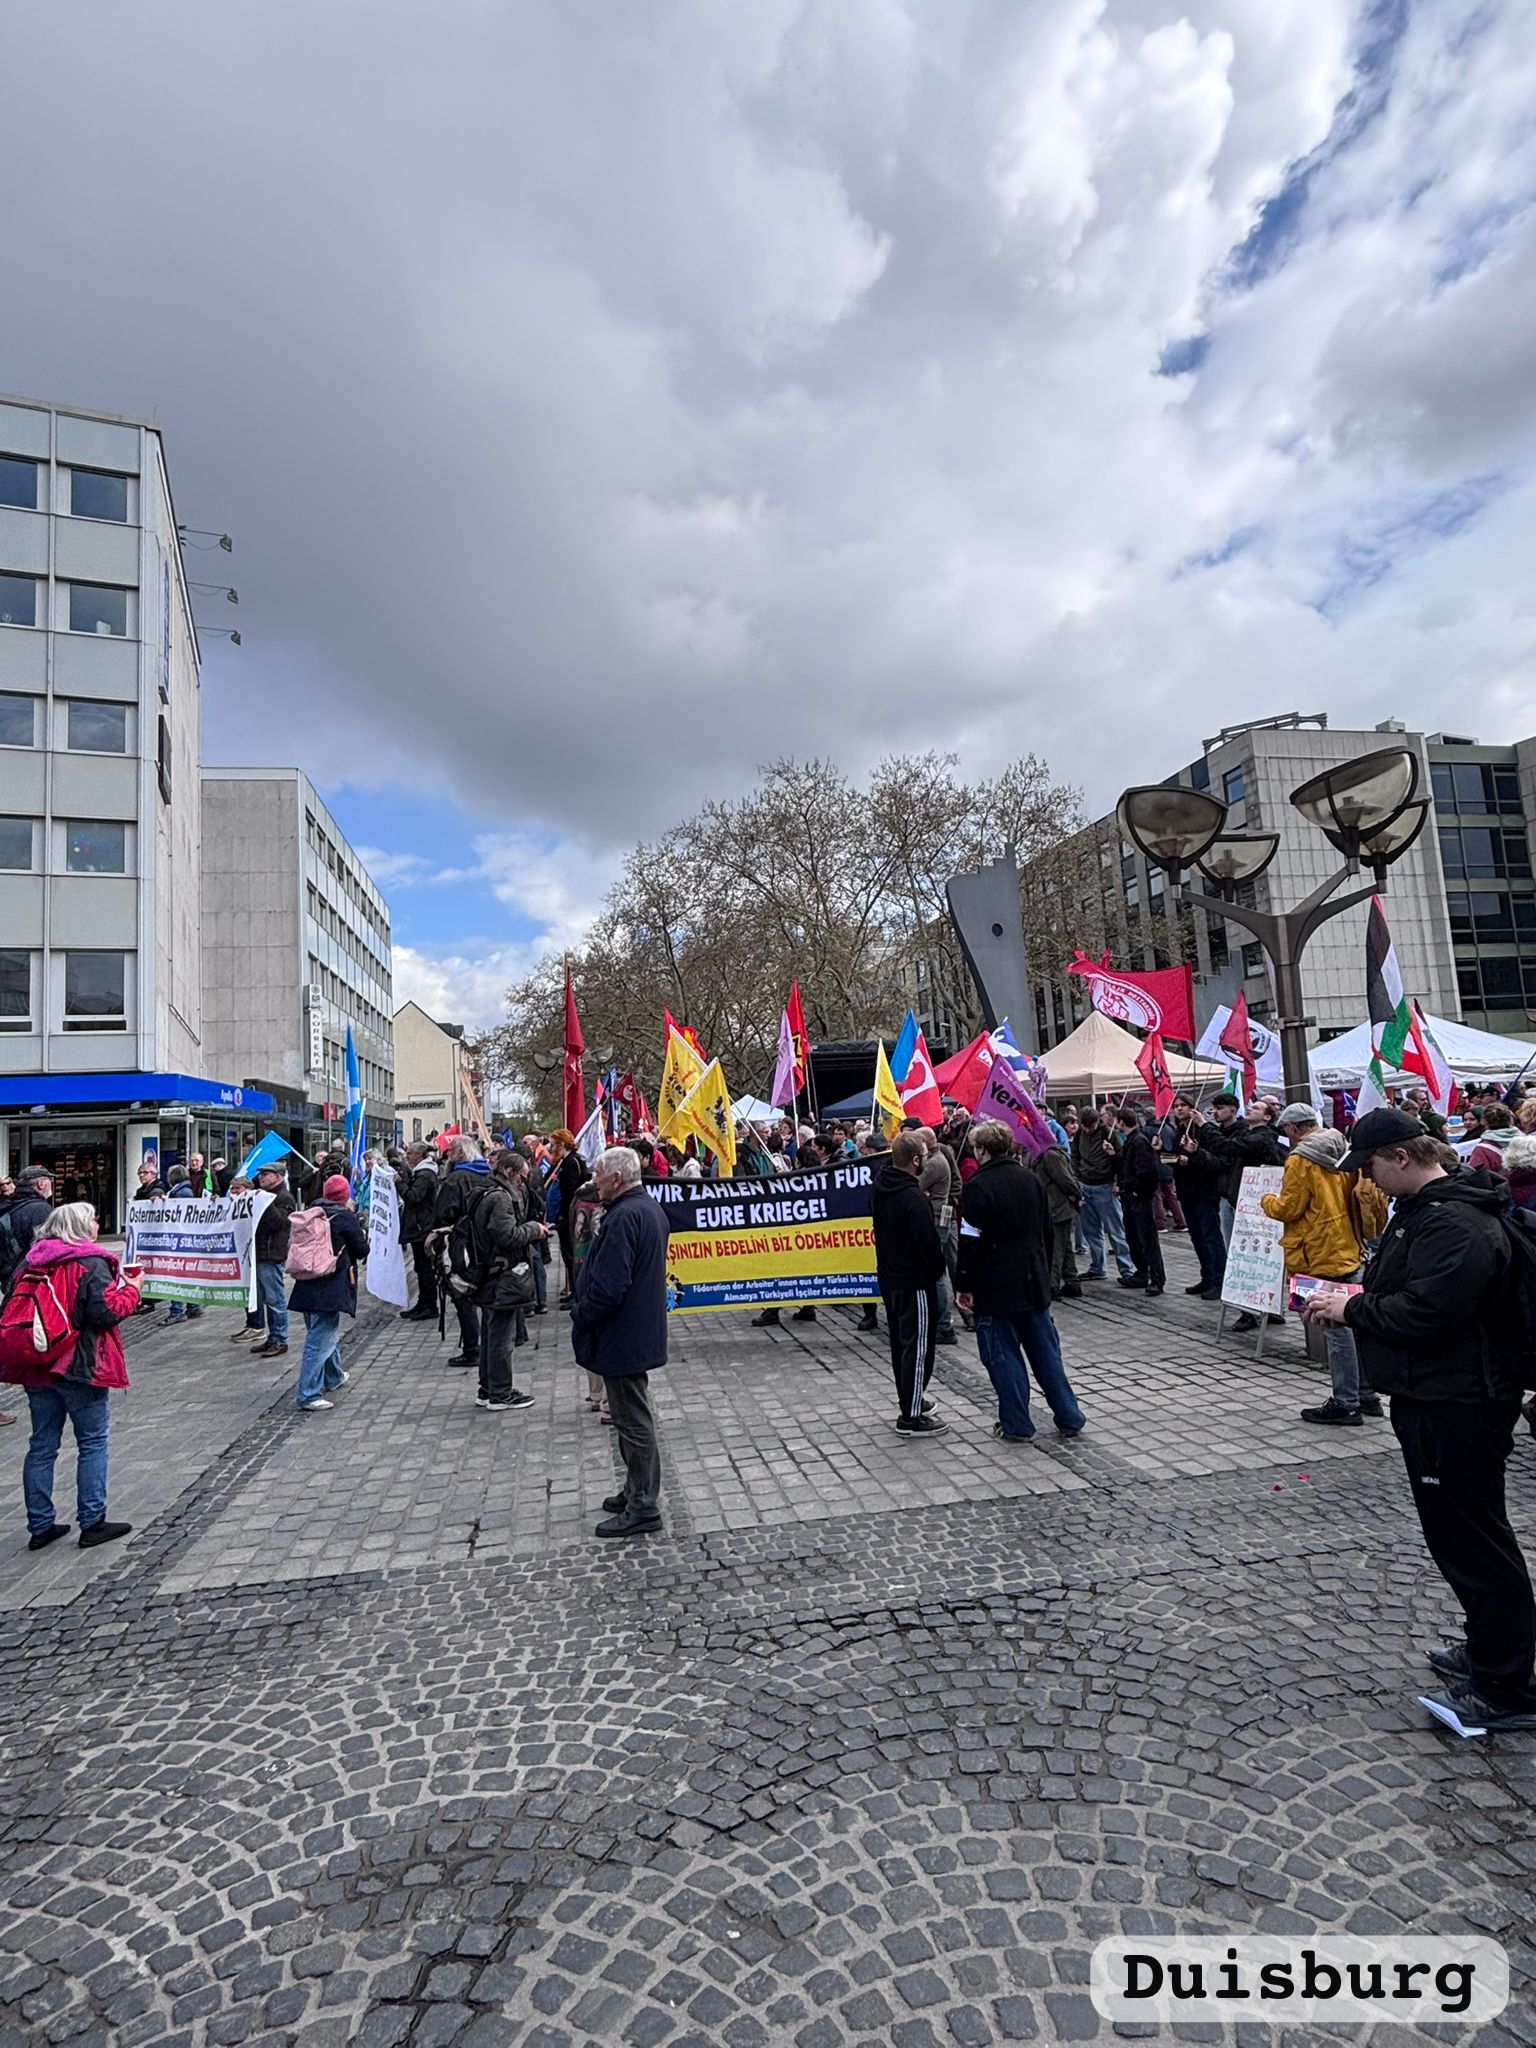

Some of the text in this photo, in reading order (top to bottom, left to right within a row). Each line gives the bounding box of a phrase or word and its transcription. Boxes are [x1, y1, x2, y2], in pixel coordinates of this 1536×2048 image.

[646, 1165, 873, 1203] WIR ZAHLEN NICHT FÜR
[129, 1205, 182, 1224] Ostermarsch
[695, 1198, 828, 1228] EURE KRIEGE!
[717, 1234, 770, 1256] BEDELİNİ
[772, 1232, 792, 1251] BİZ
[693, 1283, 731, 1293] Föderation
[732, 1281, 744, 1291] der
[813, 1277, 825, 1286] der
[826, 1275, 849, 1285] Türkei
[850, 1275, 858, 1283] in
[724, 1292, 758, 1303] Almanya
[822, 1286, 873, 1297] Federasyonu
